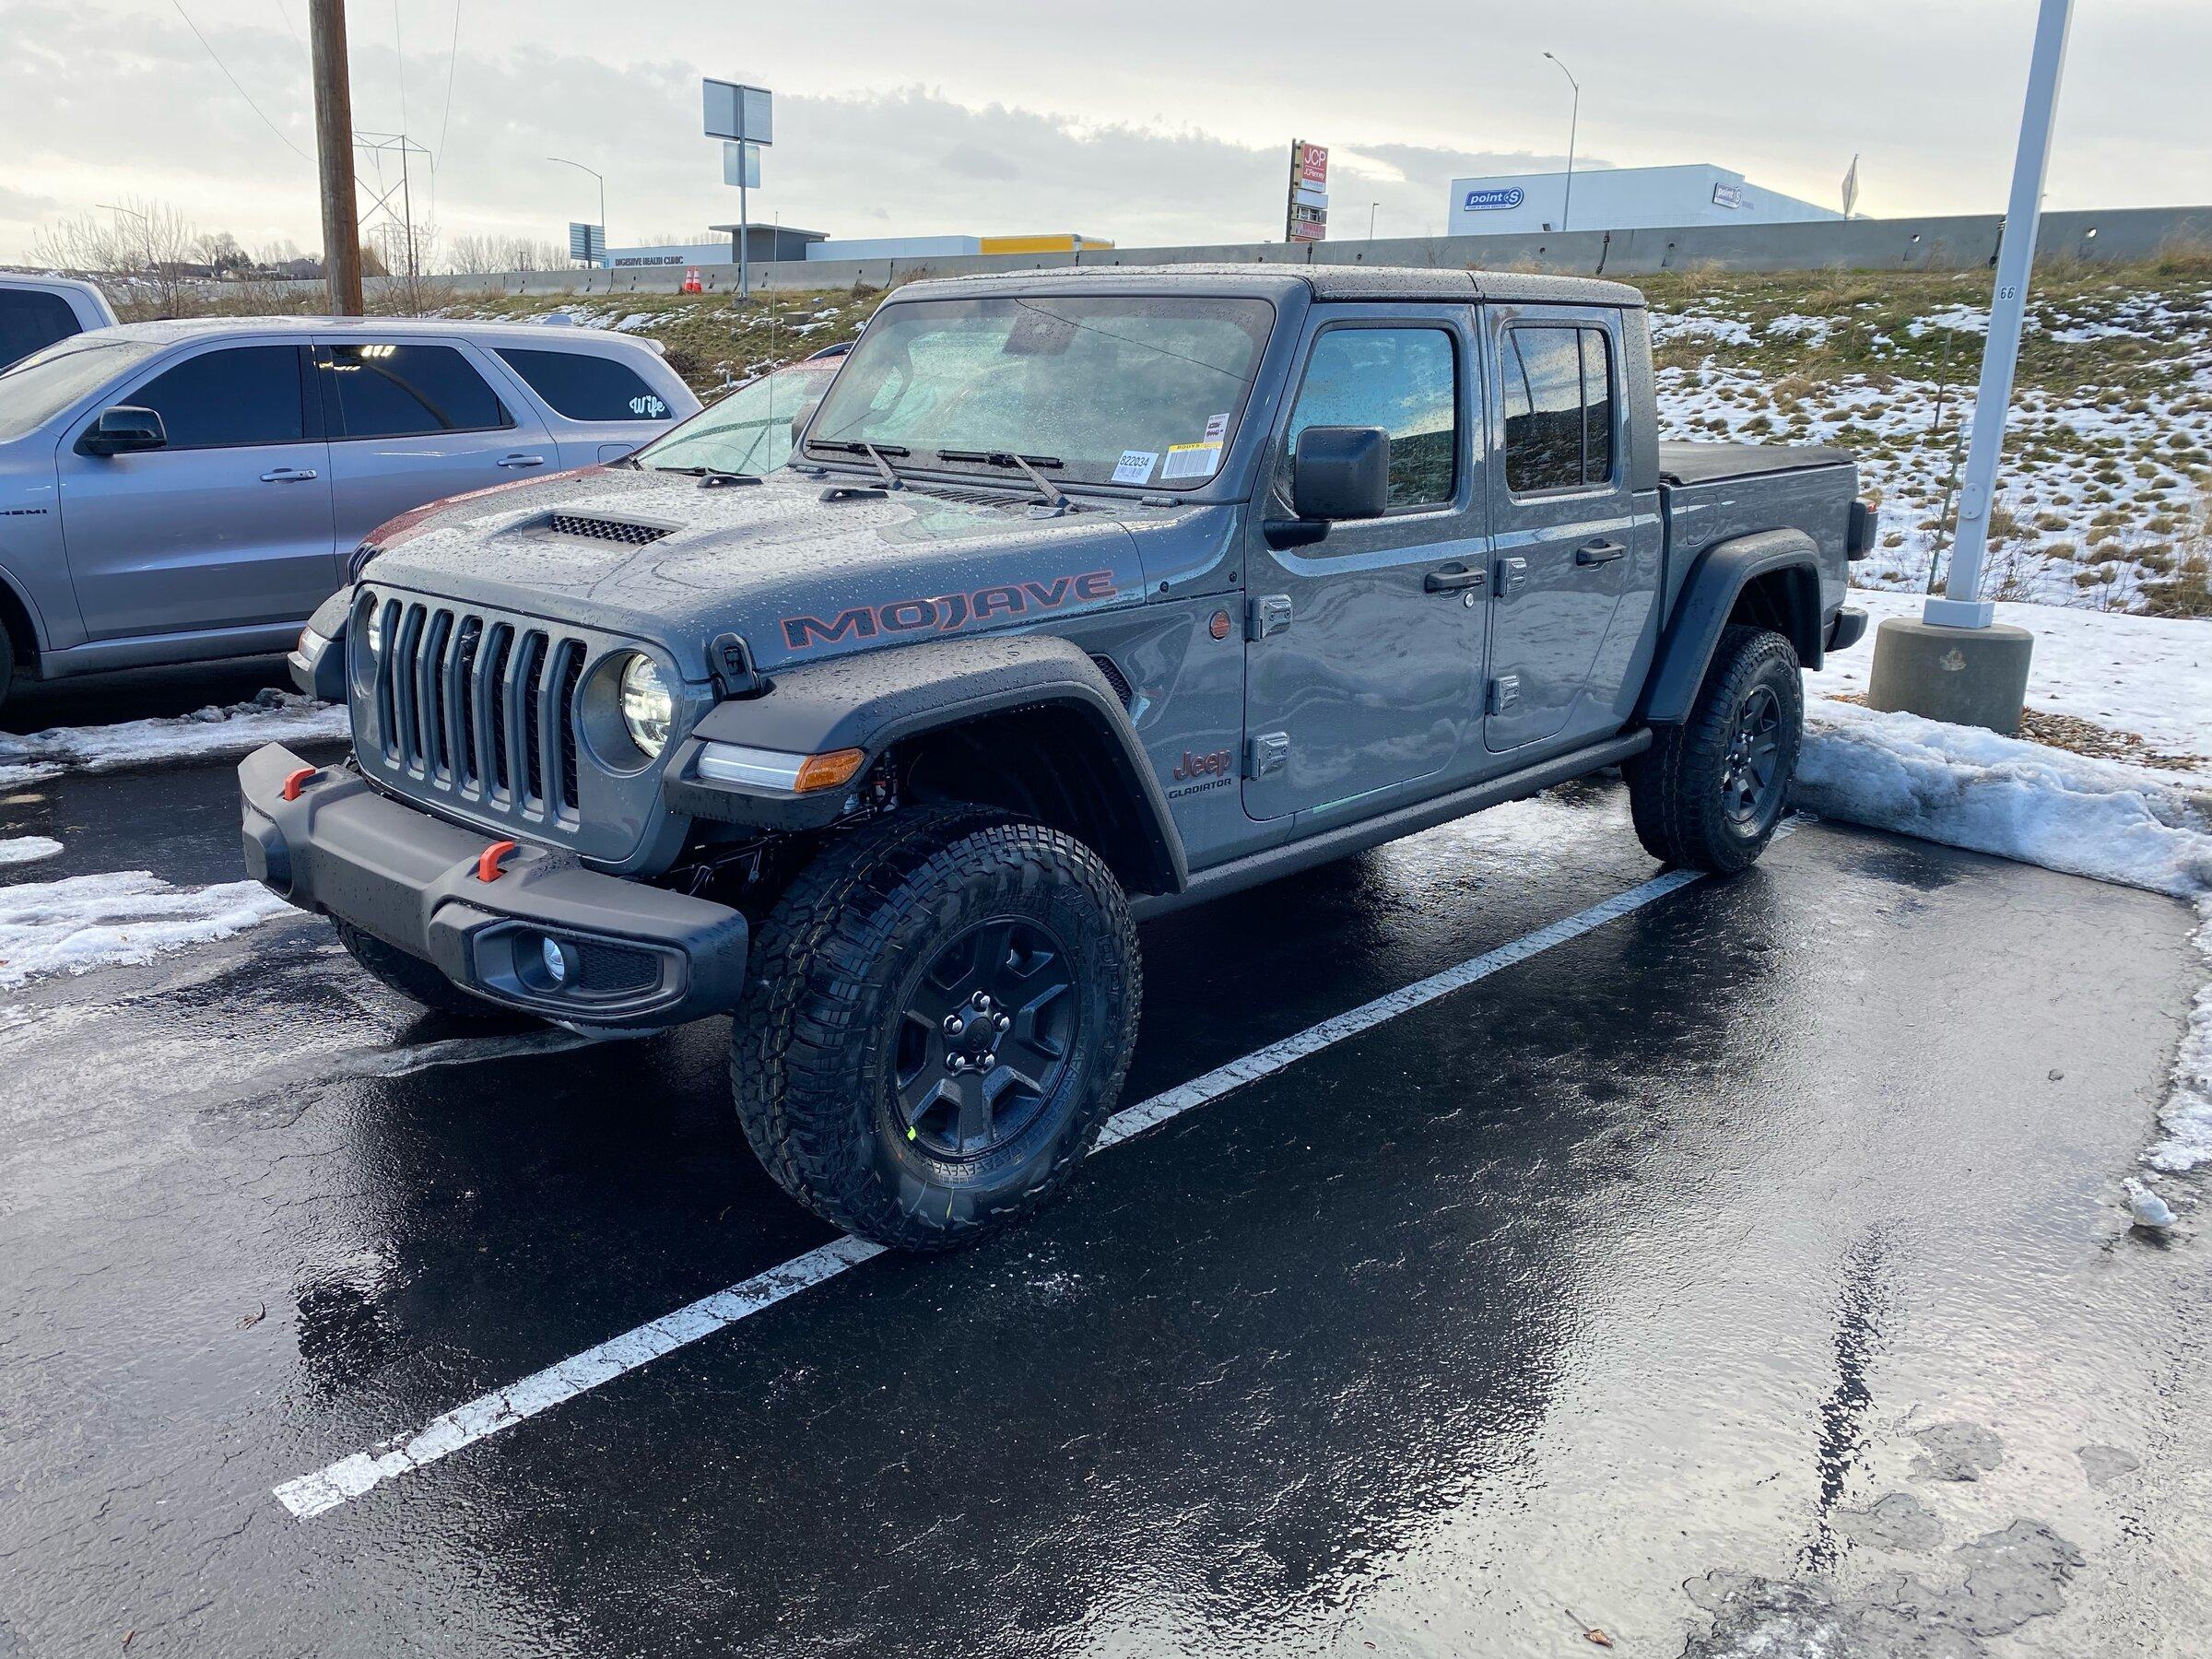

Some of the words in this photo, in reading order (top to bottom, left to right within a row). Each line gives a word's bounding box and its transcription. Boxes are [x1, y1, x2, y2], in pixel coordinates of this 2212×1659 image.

[1304, 147, 1326, 167] JCP
[1303, 168, 1325, 181] JCPenney
[1470, 193, 1503, 205] point
[615, 257, 642, 266] DIGESTIVE
[642, 256, 664, 265] HEALTH
[664, 255, 684, 265] CLINIC
[2000, 287, 2016, 300] 66
[629, 394, 665, 418] Wife
[1120, 455, 1150, 467] 822034
[780, 571, 1118, 650] MOJAVE
[1173, 748, 1233, 782] Jeep
[1169, 778, 1232, 799] GLADIATOR
